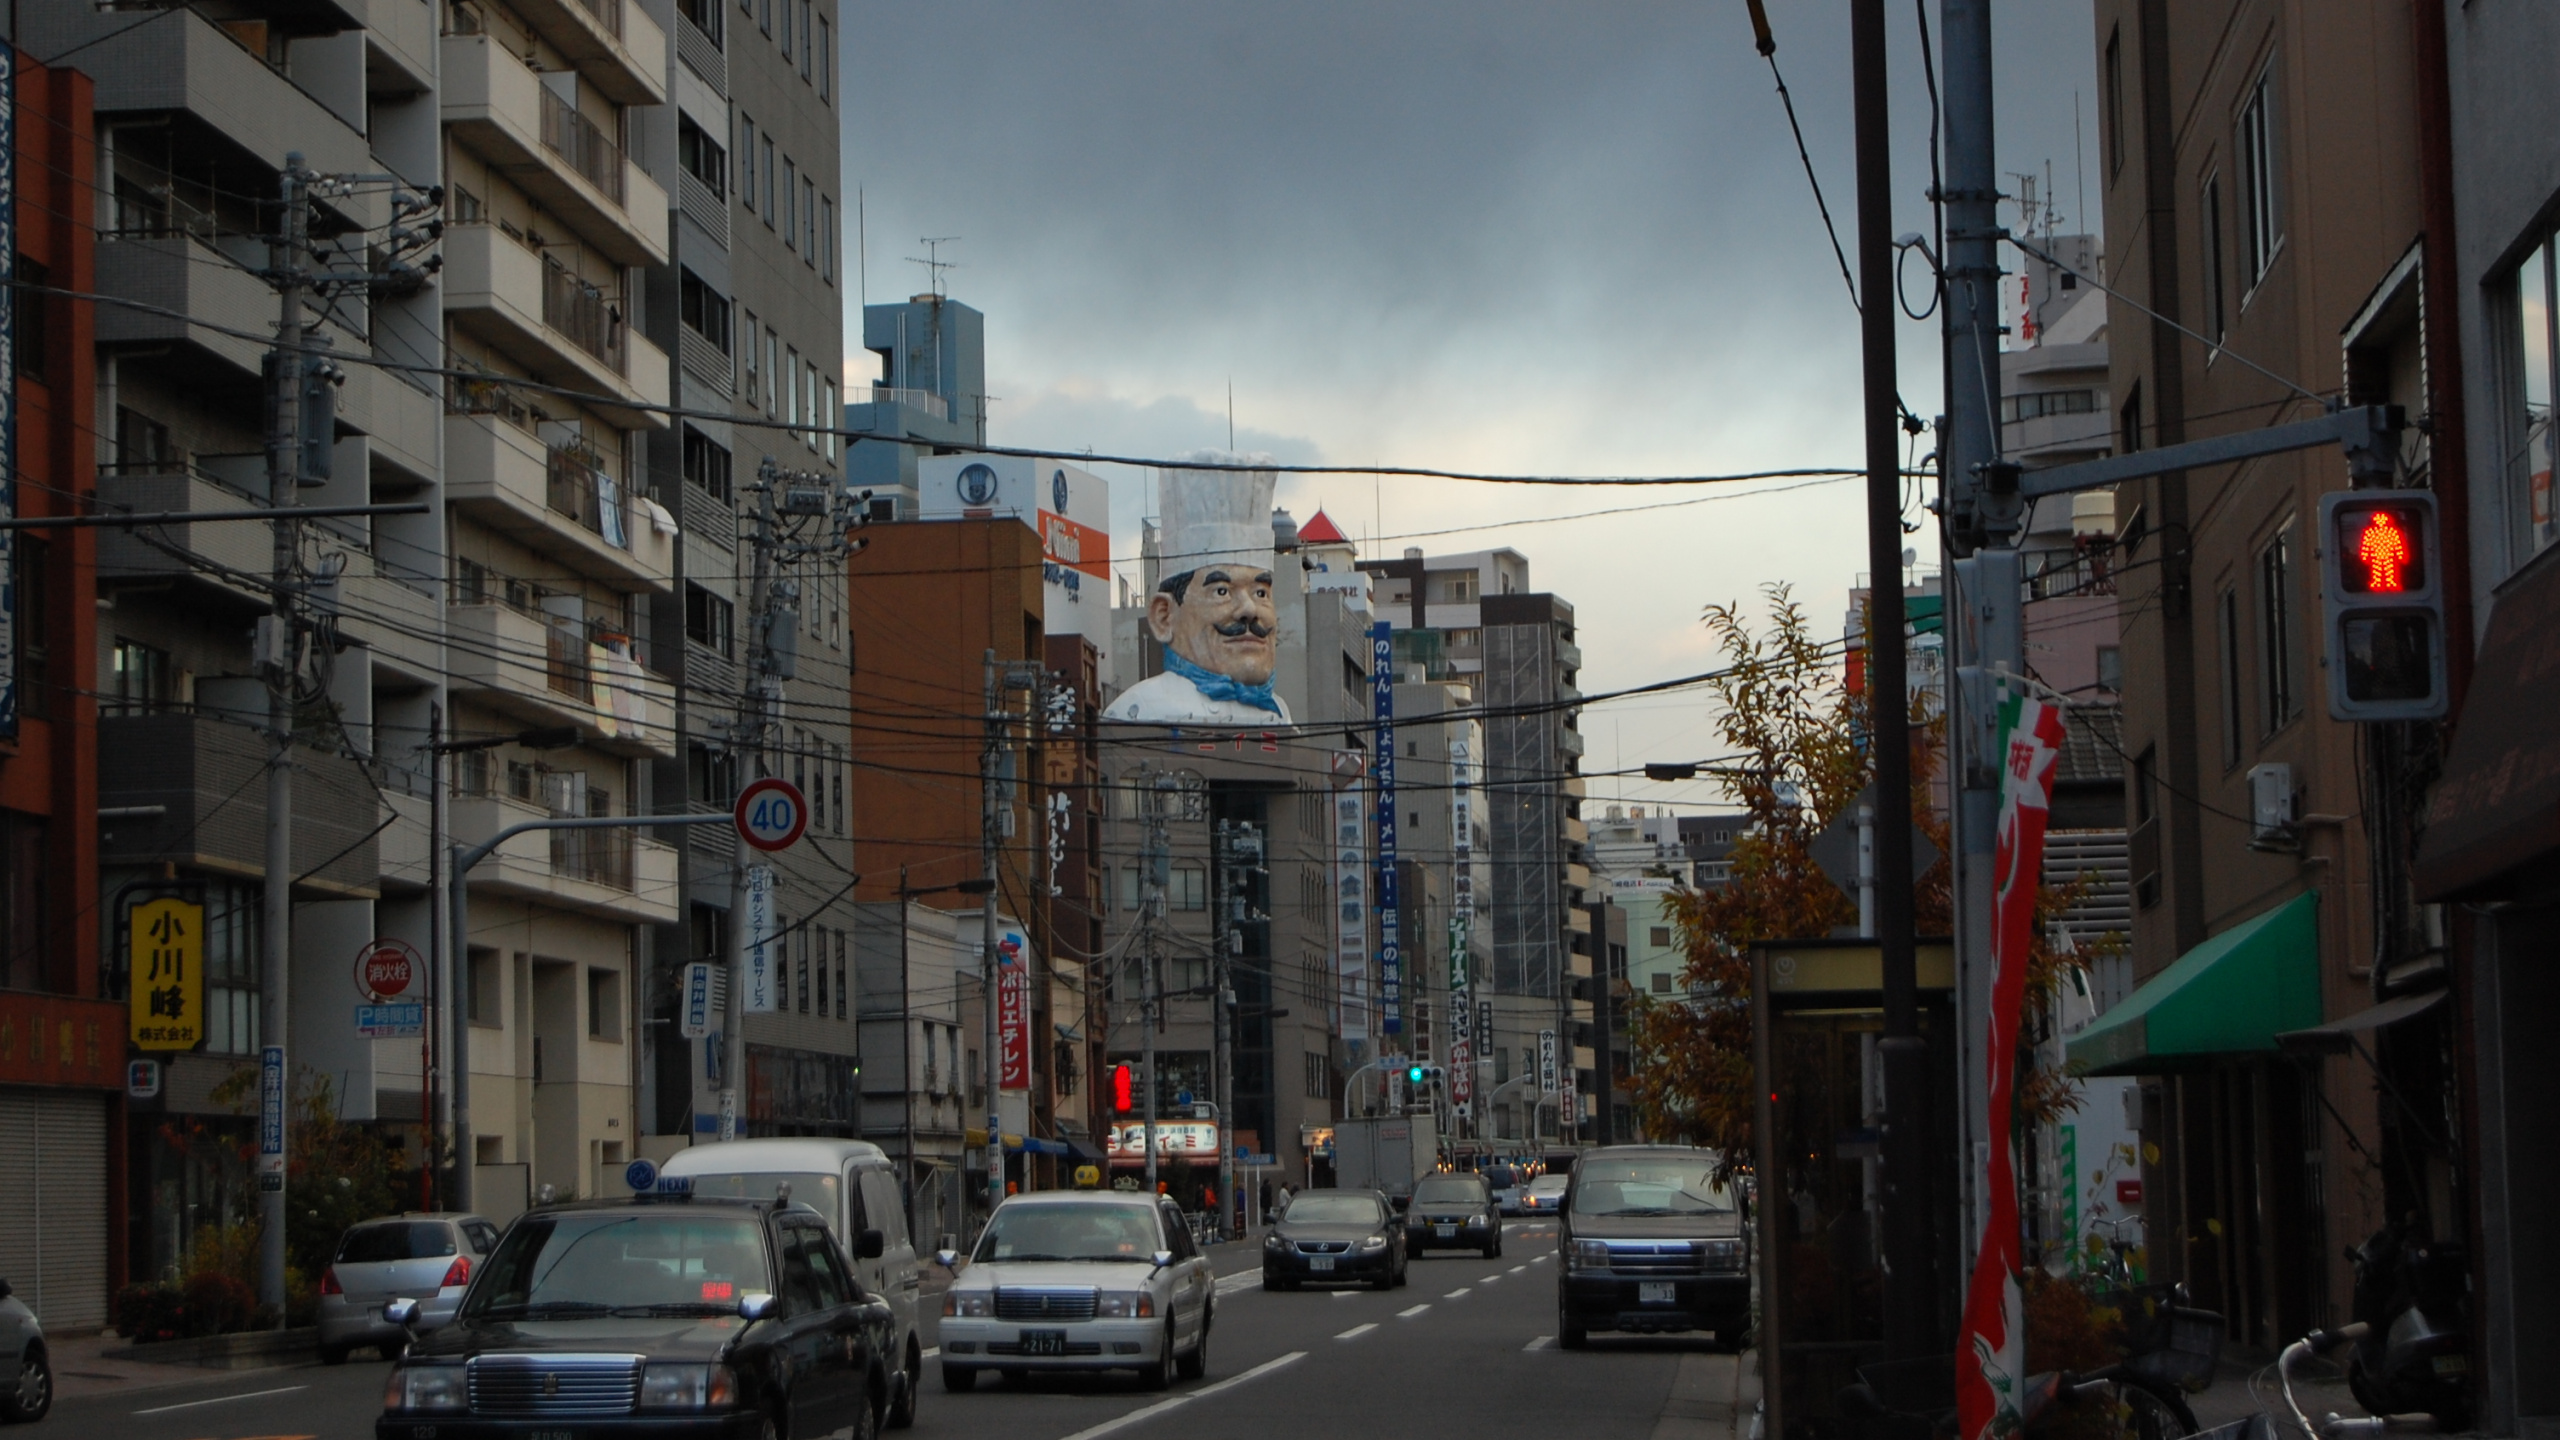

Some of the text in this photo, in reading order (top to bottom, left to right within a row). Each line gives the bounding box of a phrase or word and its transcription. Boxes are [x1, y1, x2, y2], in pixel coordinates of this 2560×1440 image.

[752, 799, 790, 830] 40
[148, 911, 185, 1019] 小川峰
[369, 961, 408, 982] 消火栓
[139, 1027, 194, 1041] 株式会社
[1002, 971, 1019, 1081] ポリエチレン
[1542, 1030, 1554, 1063] のれん
[658, 1178, 689, 1191] HEXA
